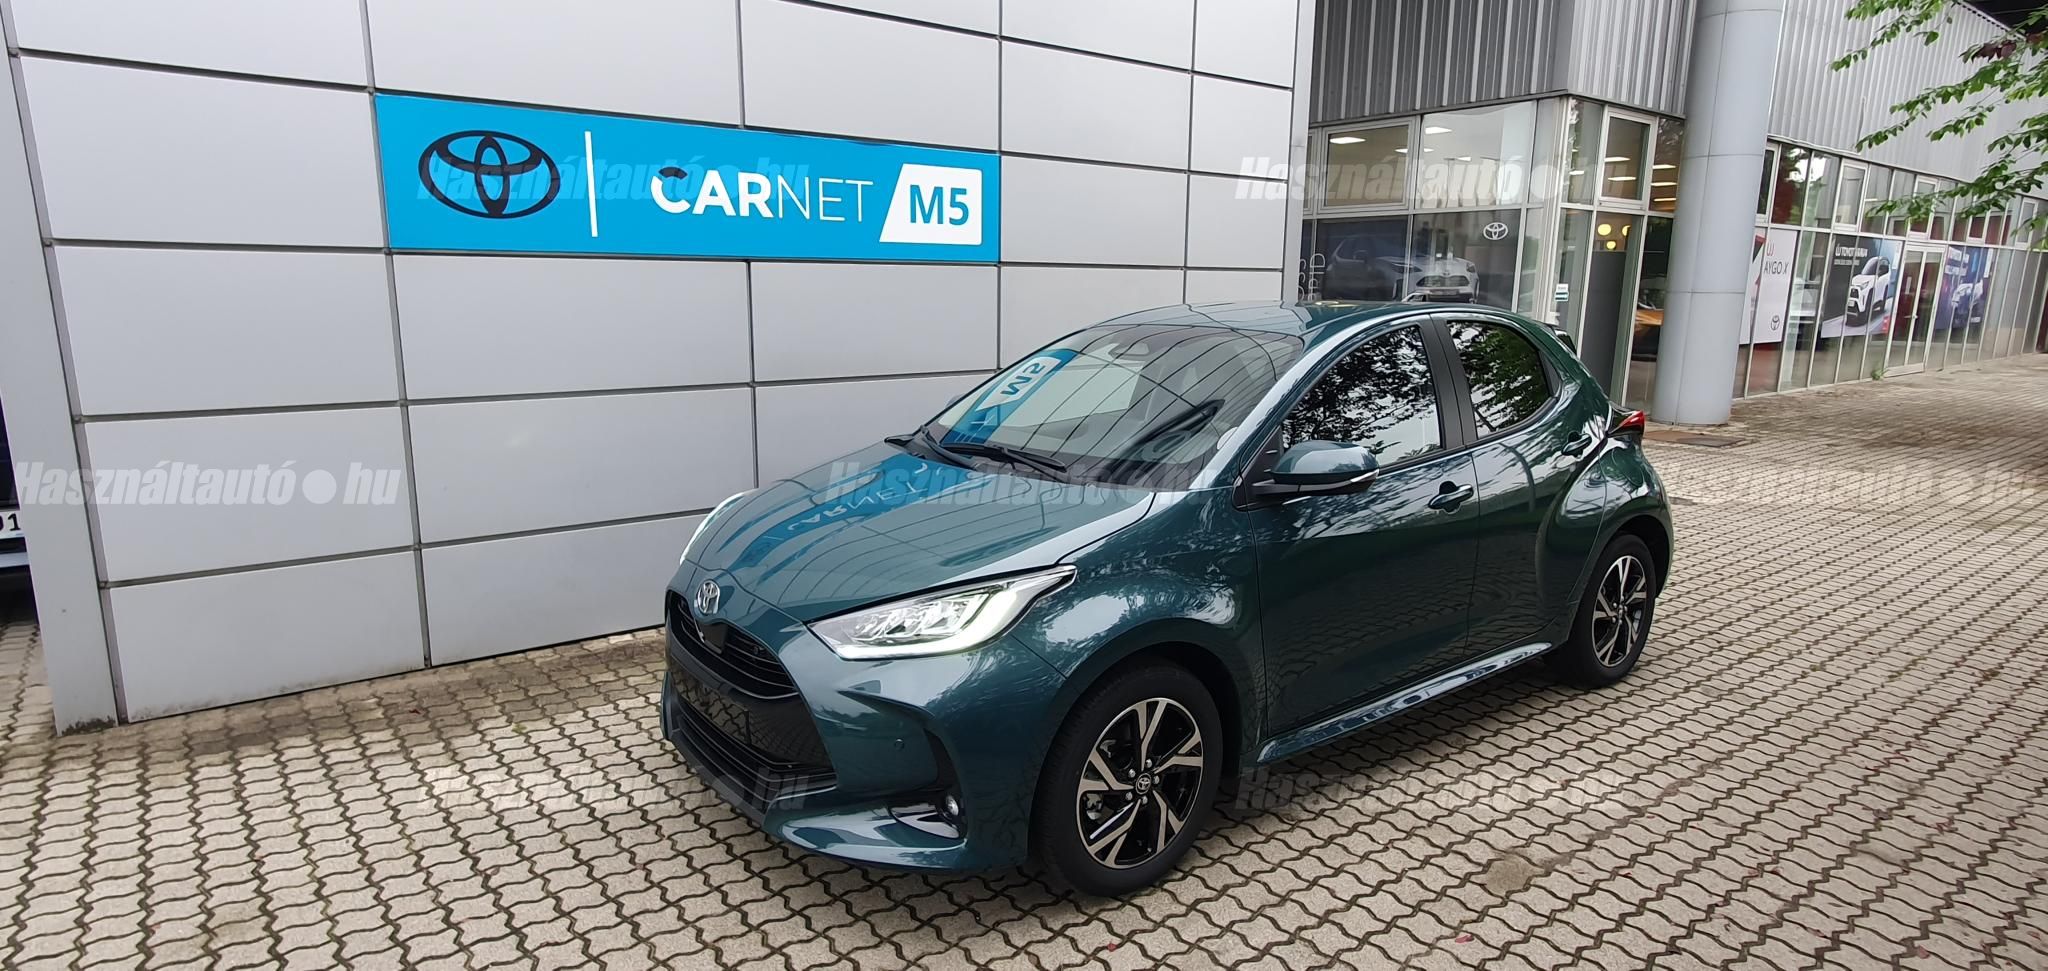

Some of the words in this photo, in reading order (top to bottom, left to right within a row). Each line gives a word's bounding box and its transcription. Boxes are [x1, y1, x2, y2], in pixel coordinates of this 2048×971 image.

[650, 166, 873, 222] CARNET
[909, 184, 969, 226] M5
[1764, 261, 1783, 275] AYGO
